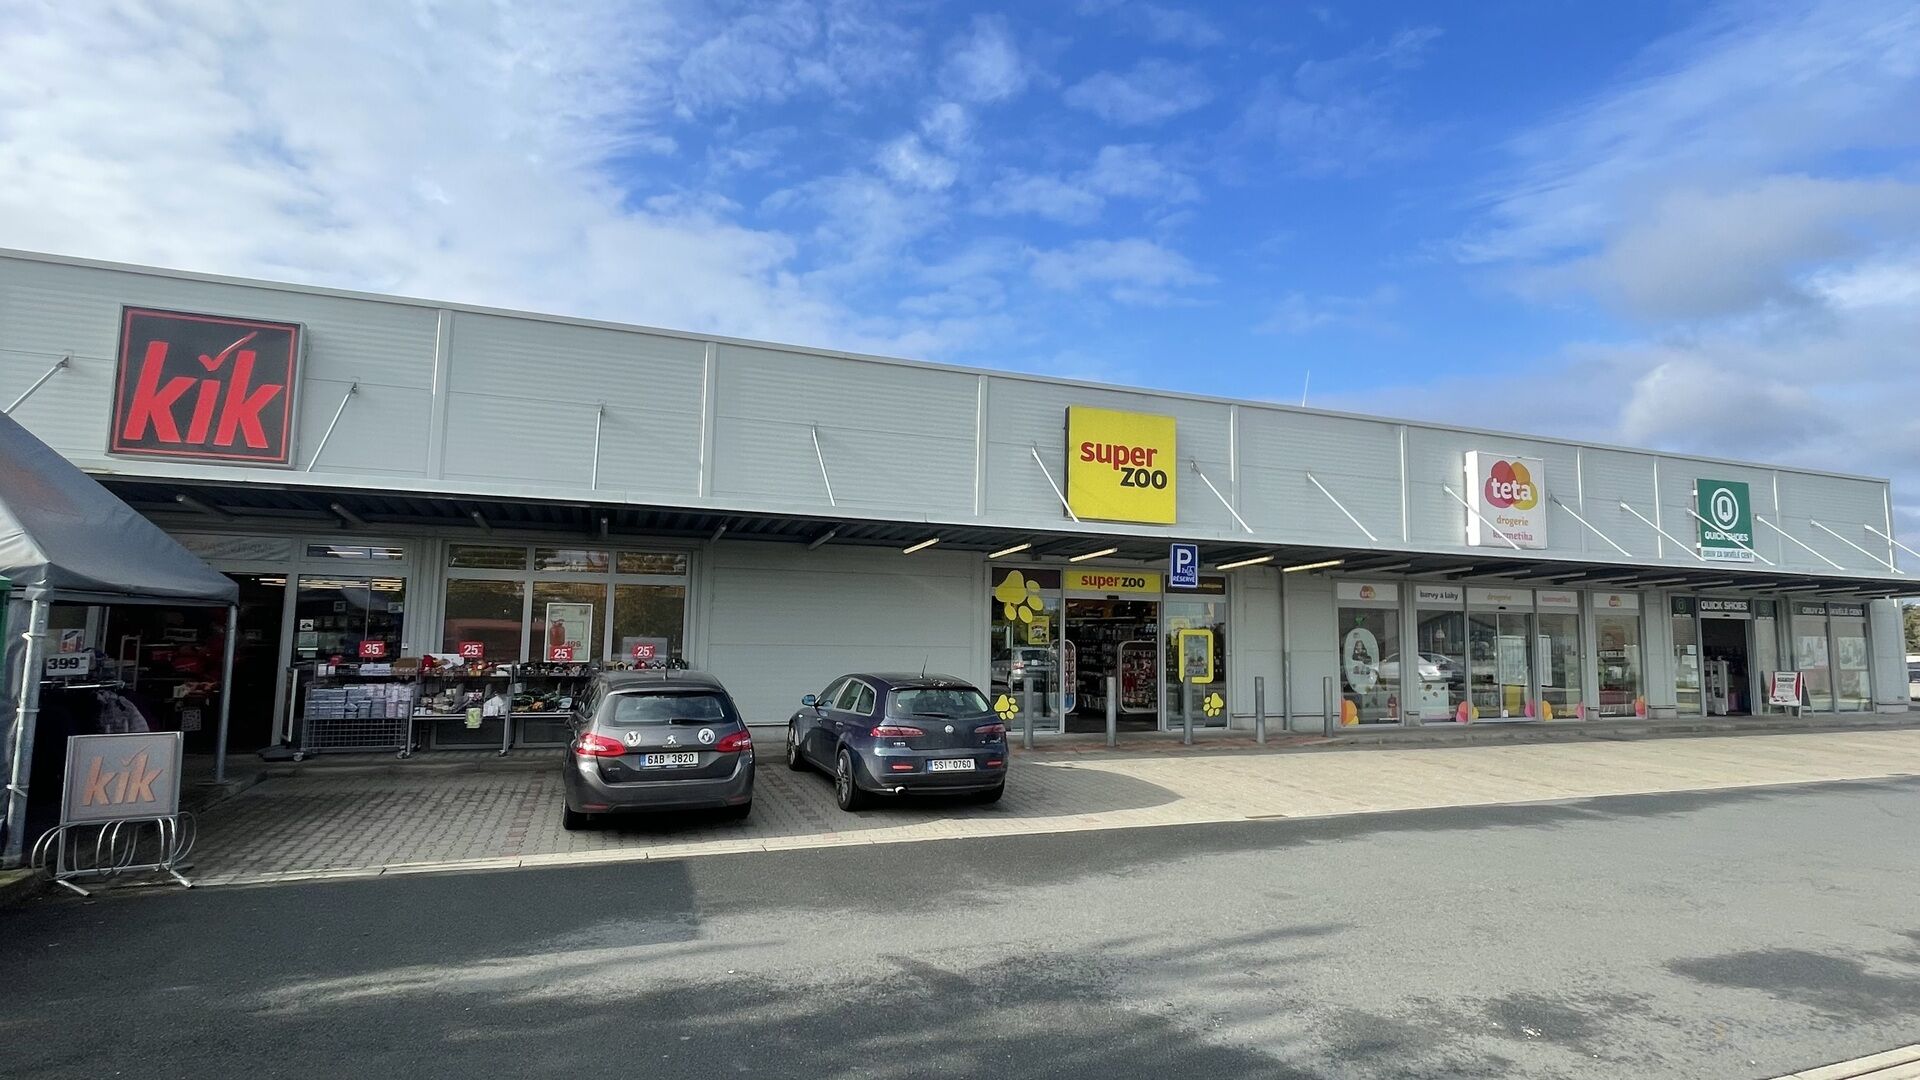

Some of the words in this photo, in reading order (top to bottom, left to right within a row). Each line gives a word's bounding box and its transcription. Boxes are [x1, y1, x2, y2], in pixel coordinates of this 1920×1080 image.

[123, 332, 284, 448] kik
[1080, 441, 1158, 470] super
[1120, 466, 1168, 490] zoo
[1491, 477, 1533, 501] teta
[1496, 514, 1529, 527] drogerie
[1176, 548, 1193, 574] P
[1081, 575, 1119, 589] super
[1121, 577, 1145, 588] zoo
[1701, 600, 1722, 610] QUICK
[1723, 602, 1748, 610] SHOES
[365, 643, 379, 654] 35
[464, 644, 478, 655] 25
[636, 646, 650, 657] 25
[48, 657, 79, 670] 399
[647, 754, 665, 764] 6AB
[671, 753, 695, 763] 3820
[82, 745, 164, 806] kik
